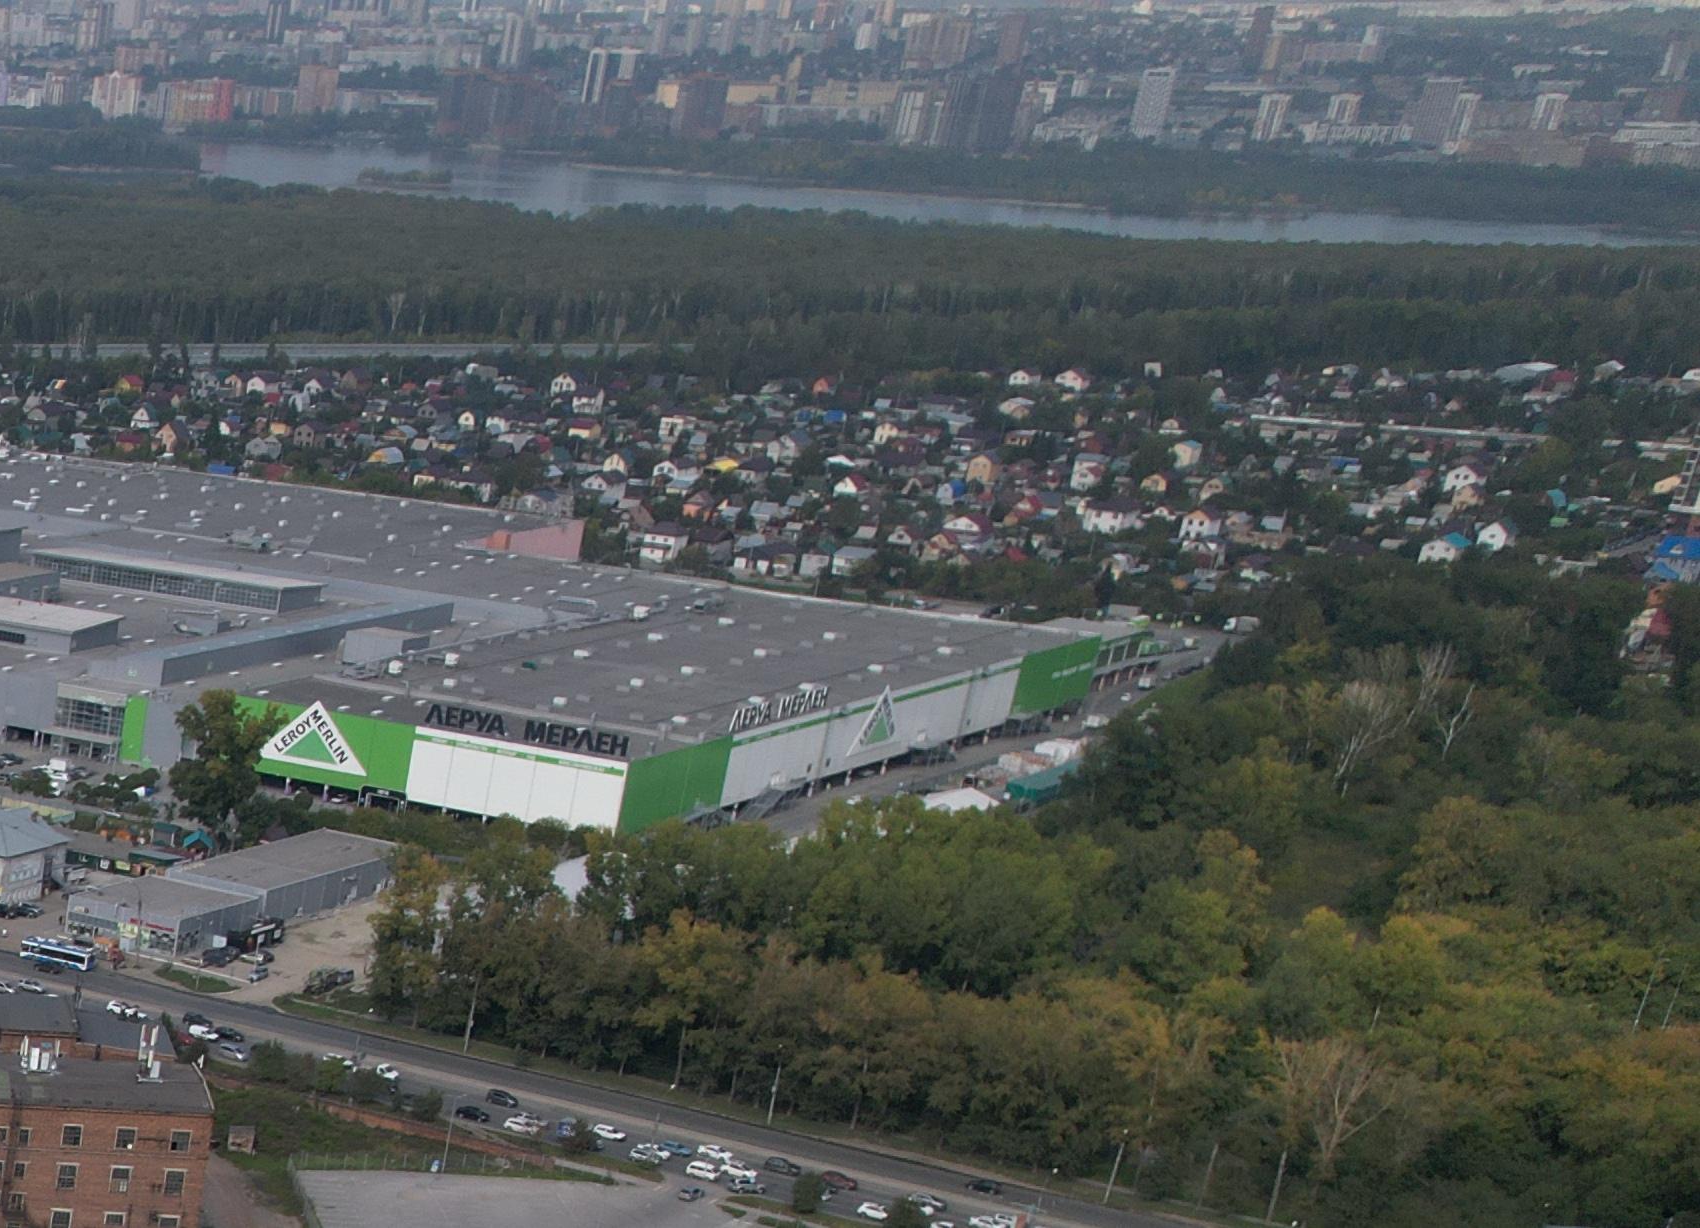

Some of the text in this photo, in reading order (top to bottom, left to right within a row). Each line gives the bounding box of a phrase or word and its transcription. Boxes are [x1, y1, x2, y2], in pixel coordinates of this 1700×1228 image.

[274, 709, 348, 765] LEROY MERLIN
[424, 704, 630, 757] ЛЕРУА МЕРЛЕН
